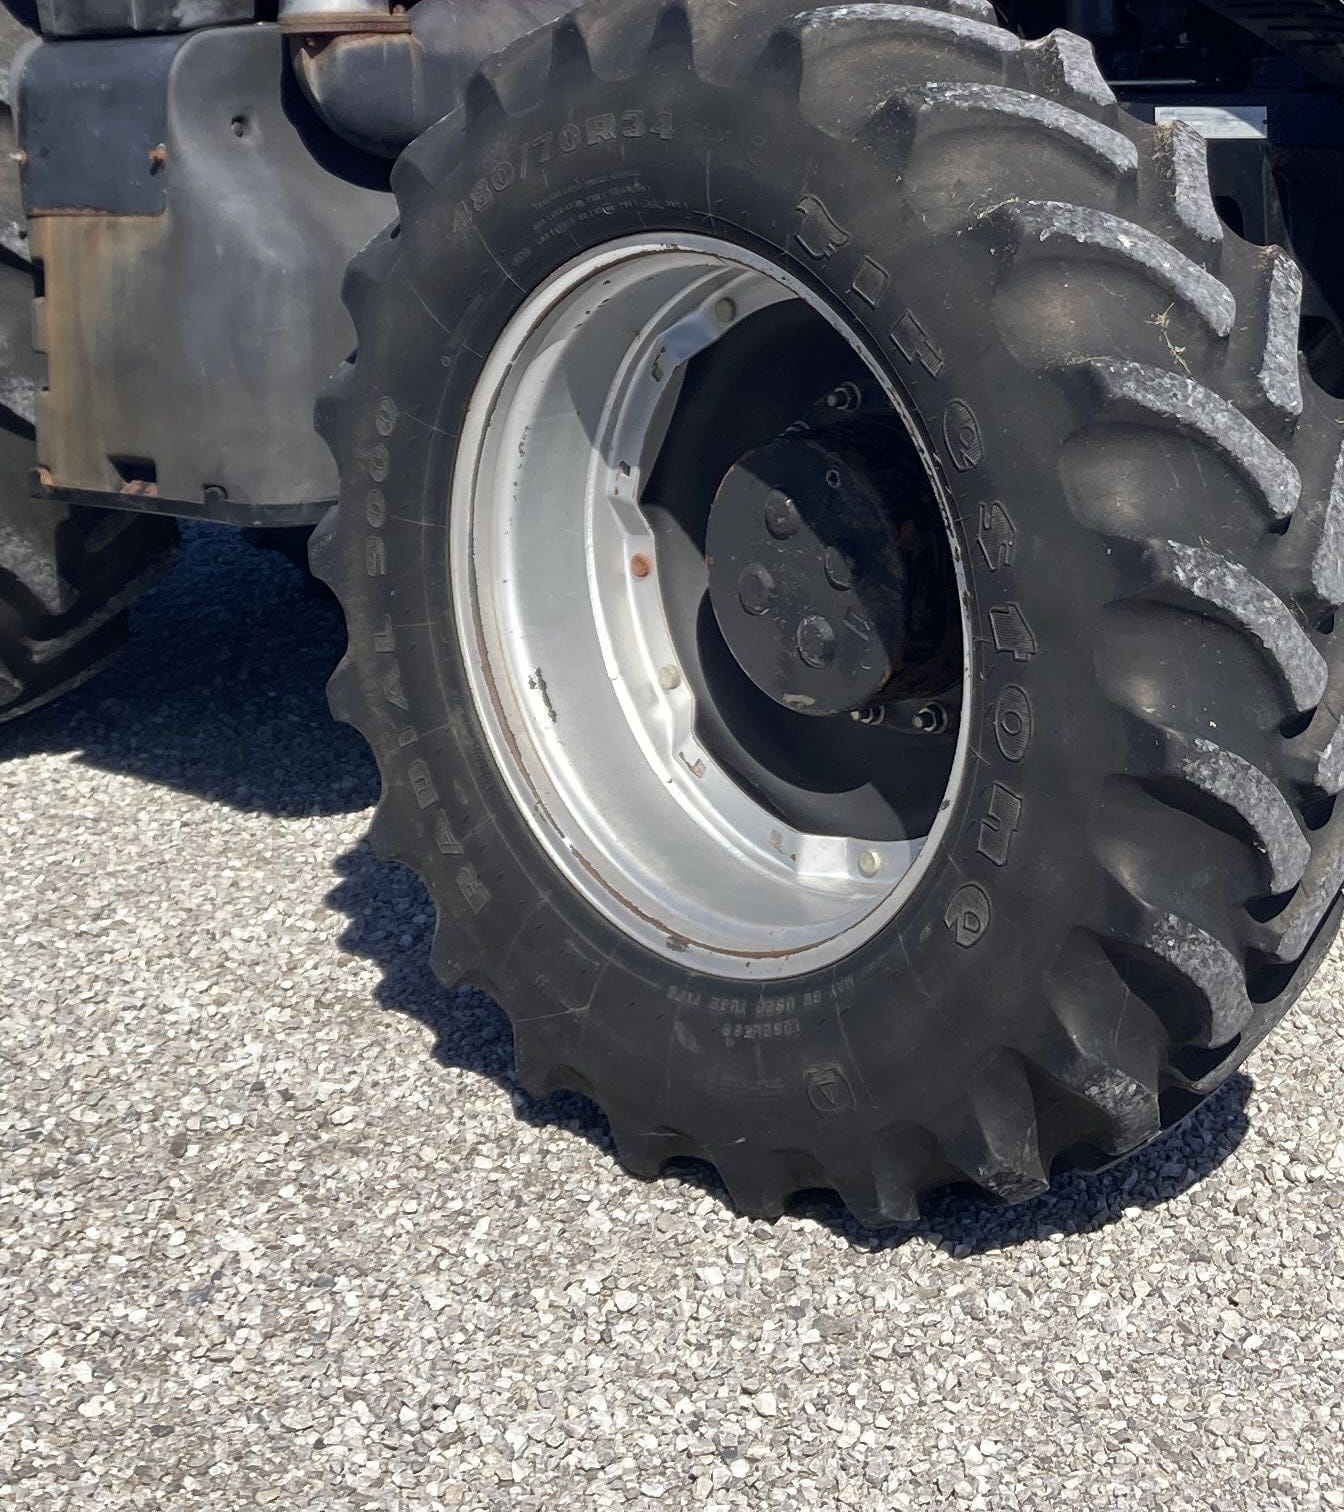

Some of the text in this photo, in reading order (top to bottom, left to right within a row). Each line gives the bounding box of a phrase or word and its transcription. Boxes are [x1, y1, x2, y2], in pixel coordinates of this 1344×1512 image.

[453, 109, 674, 232] 480/70R34
[794, 192, 1039, 950] Firestone
[374, 613, 492, 915] RADIAL
